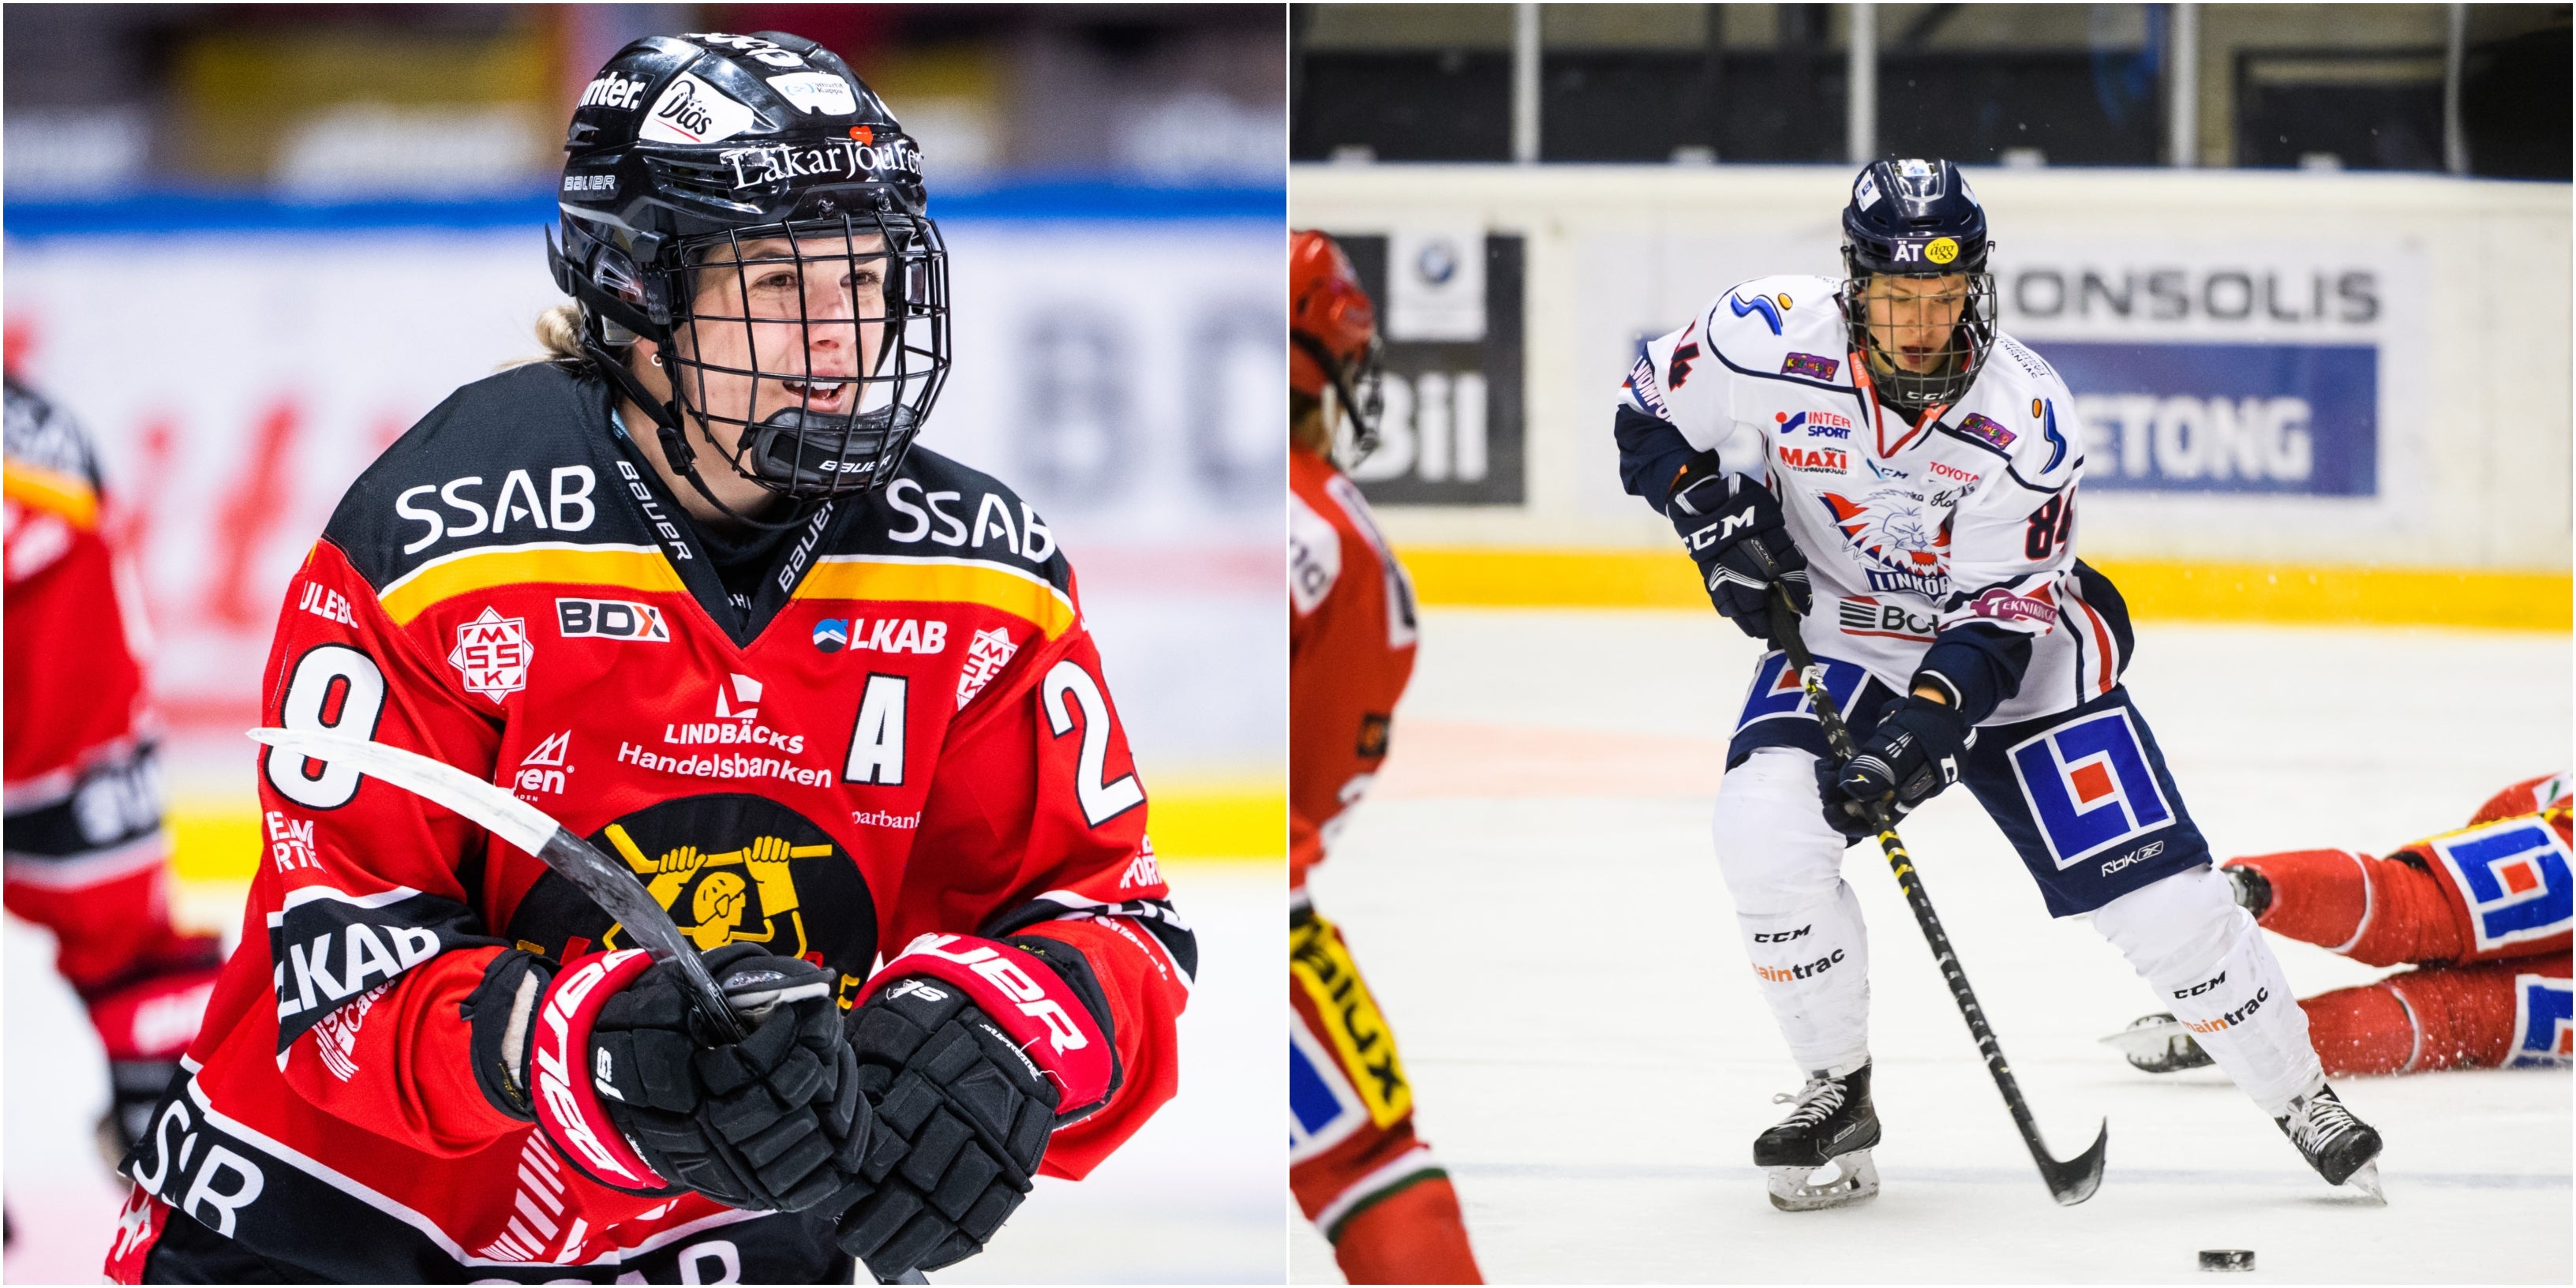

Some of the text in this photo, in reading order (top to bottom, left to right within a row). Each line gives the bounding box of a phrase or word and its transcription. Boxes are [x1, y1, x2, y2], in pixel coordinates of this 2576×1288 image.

[1894, 241, 1956, 262] ÄT ägg
[1808, 411, 1852, 429] INTER
[1808, 426, 1852, 440] SPORT
[1779, 446, 1847, 470] MAXI
[395, 465, 597, 555] SSAB
[886, 478, 1056, 563] SSAB
[560, 601, 668, 640] BDX
[851, 619, 947, 654] LKAB
[664, 718, 804, 754] LINDBÄCKS
[841, 671, 909, 786] A
[617, 742, 832, 788] Handelsbanken
[1754, 923, 1812, 944] CCM
[1752, 948, 1845, 983] aintrac
[2173, 970, 2226, 999] CCM
